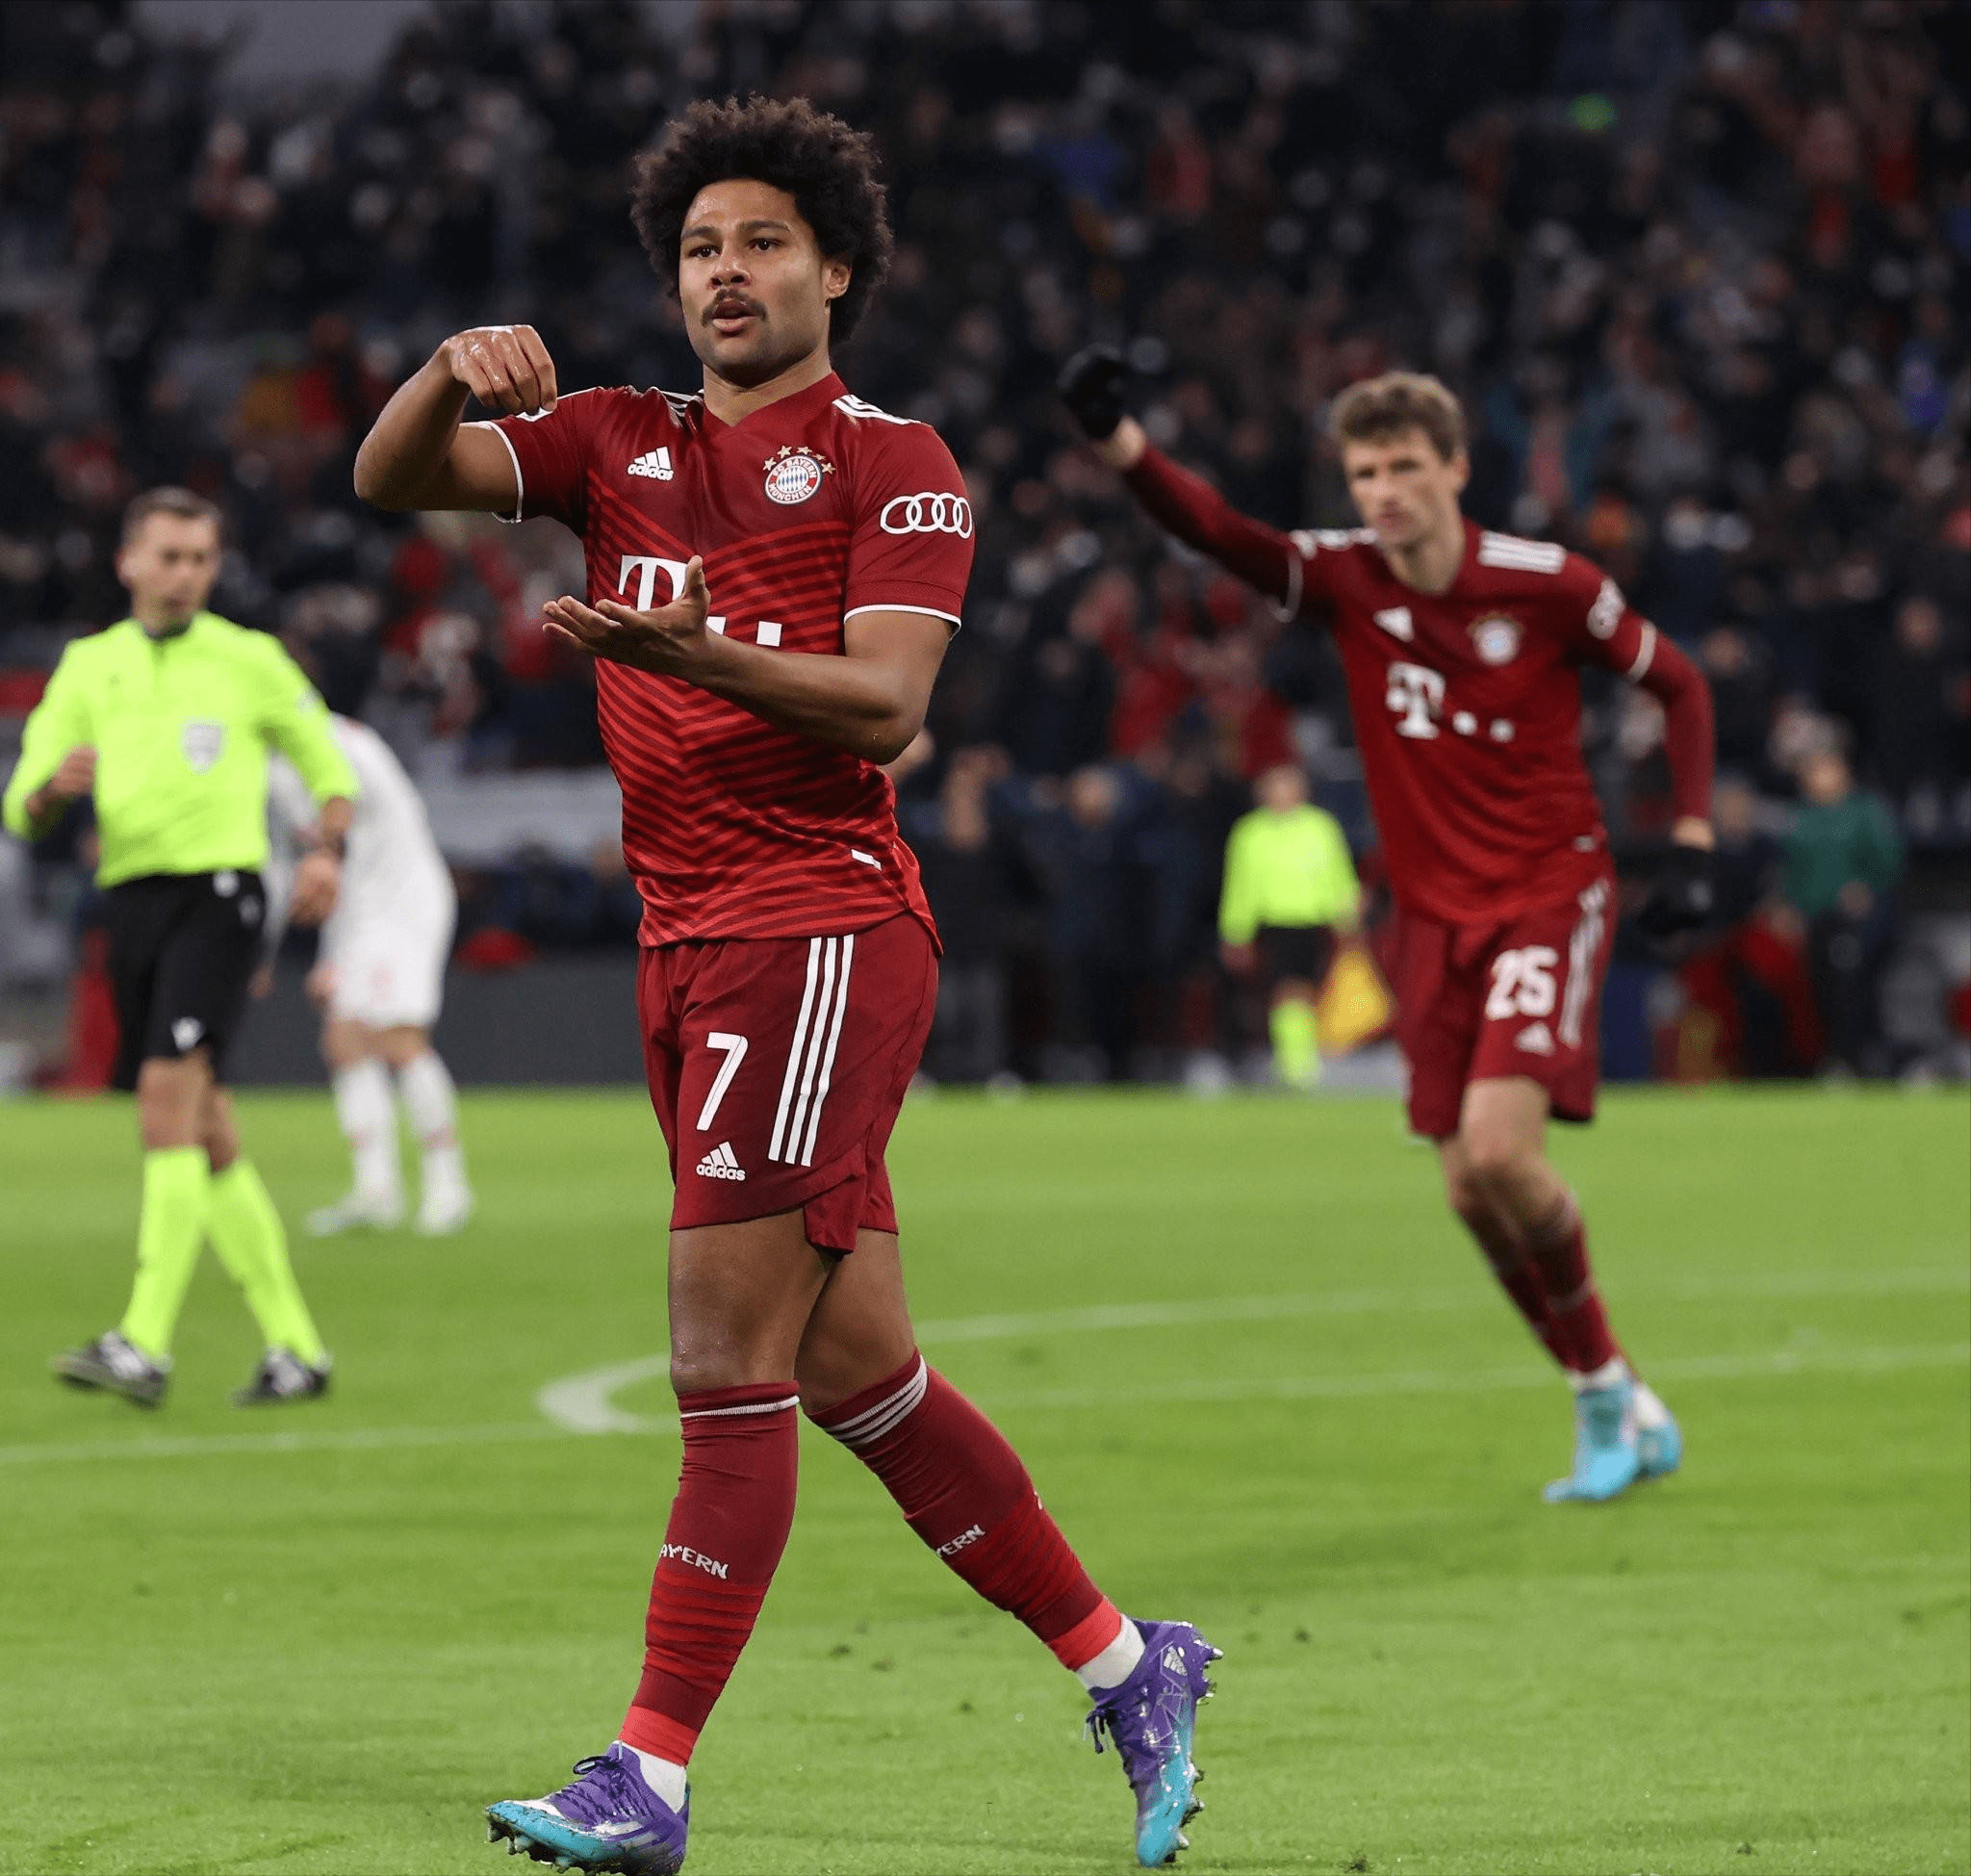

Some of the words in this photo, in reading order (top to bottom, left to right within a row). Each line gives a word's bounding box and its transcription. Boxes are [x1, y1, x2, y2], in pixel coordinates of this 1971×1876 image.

[627, 463, 674, 480] adidas
[786, 458, 817, 478] BAYERN
[1485, 945, 1559, 1020] 25
[696, 1032, 749, 1131] 7
[696, 1164, 746, 1181] adidas
